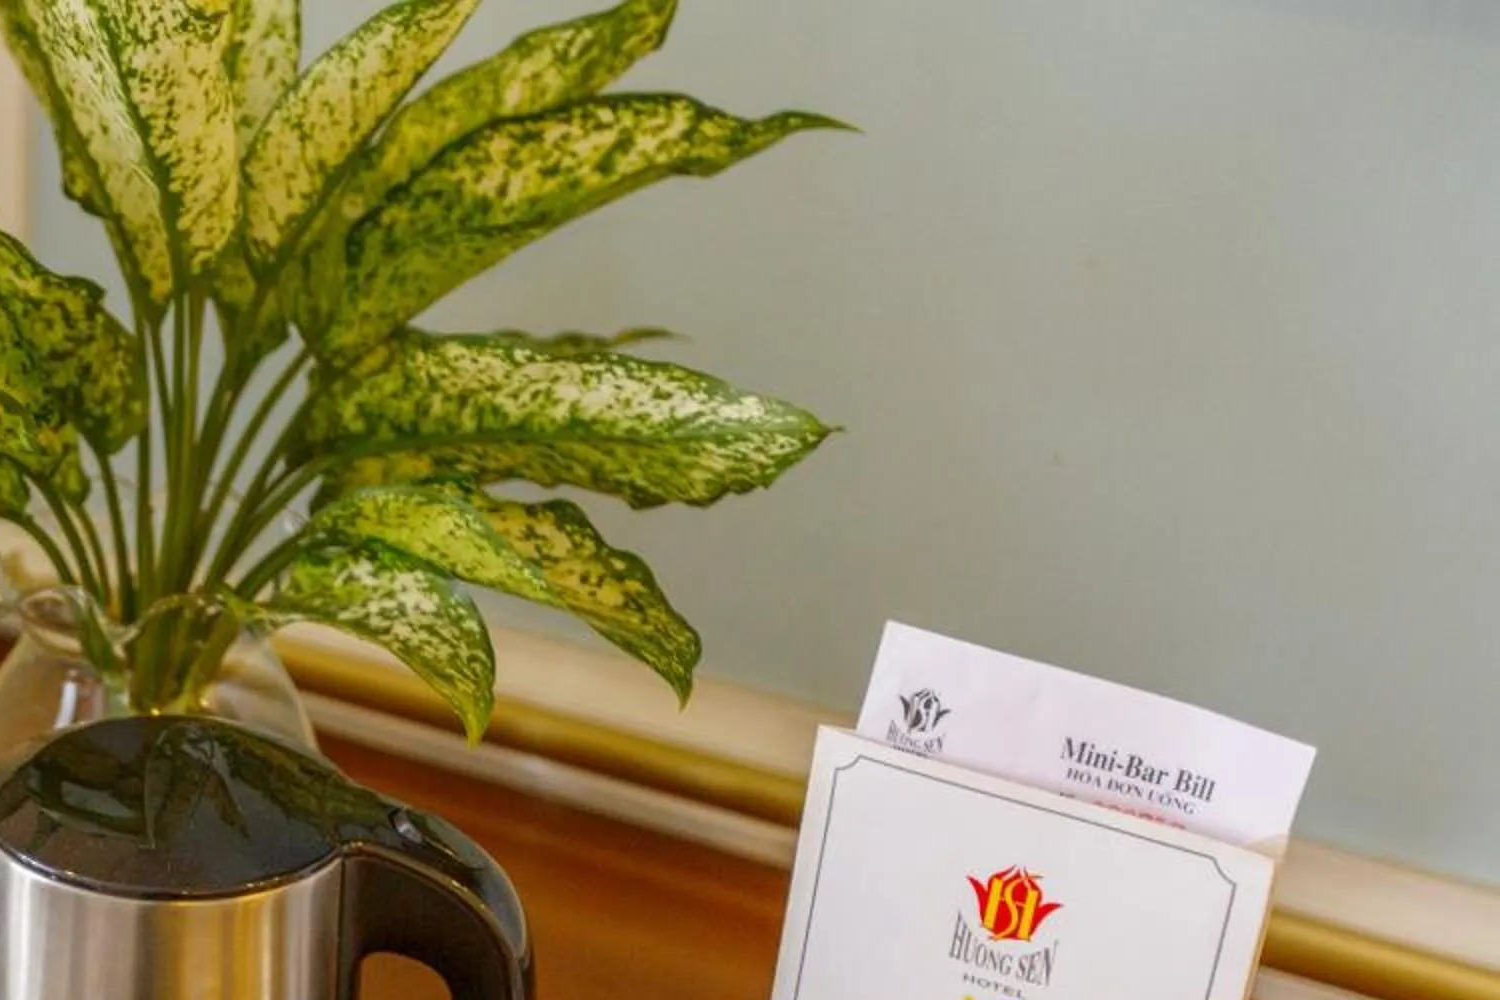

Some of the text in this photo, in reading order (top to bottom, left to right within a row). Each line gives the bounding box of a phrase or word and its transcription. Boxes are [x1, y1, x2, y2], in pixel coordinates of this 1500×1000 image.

[1060, 736, 1216, 802] Mini-Bar Bill
[962, 972, 1028, 1000] HOTEL
[1014, 938, 1059, 987] SEN
